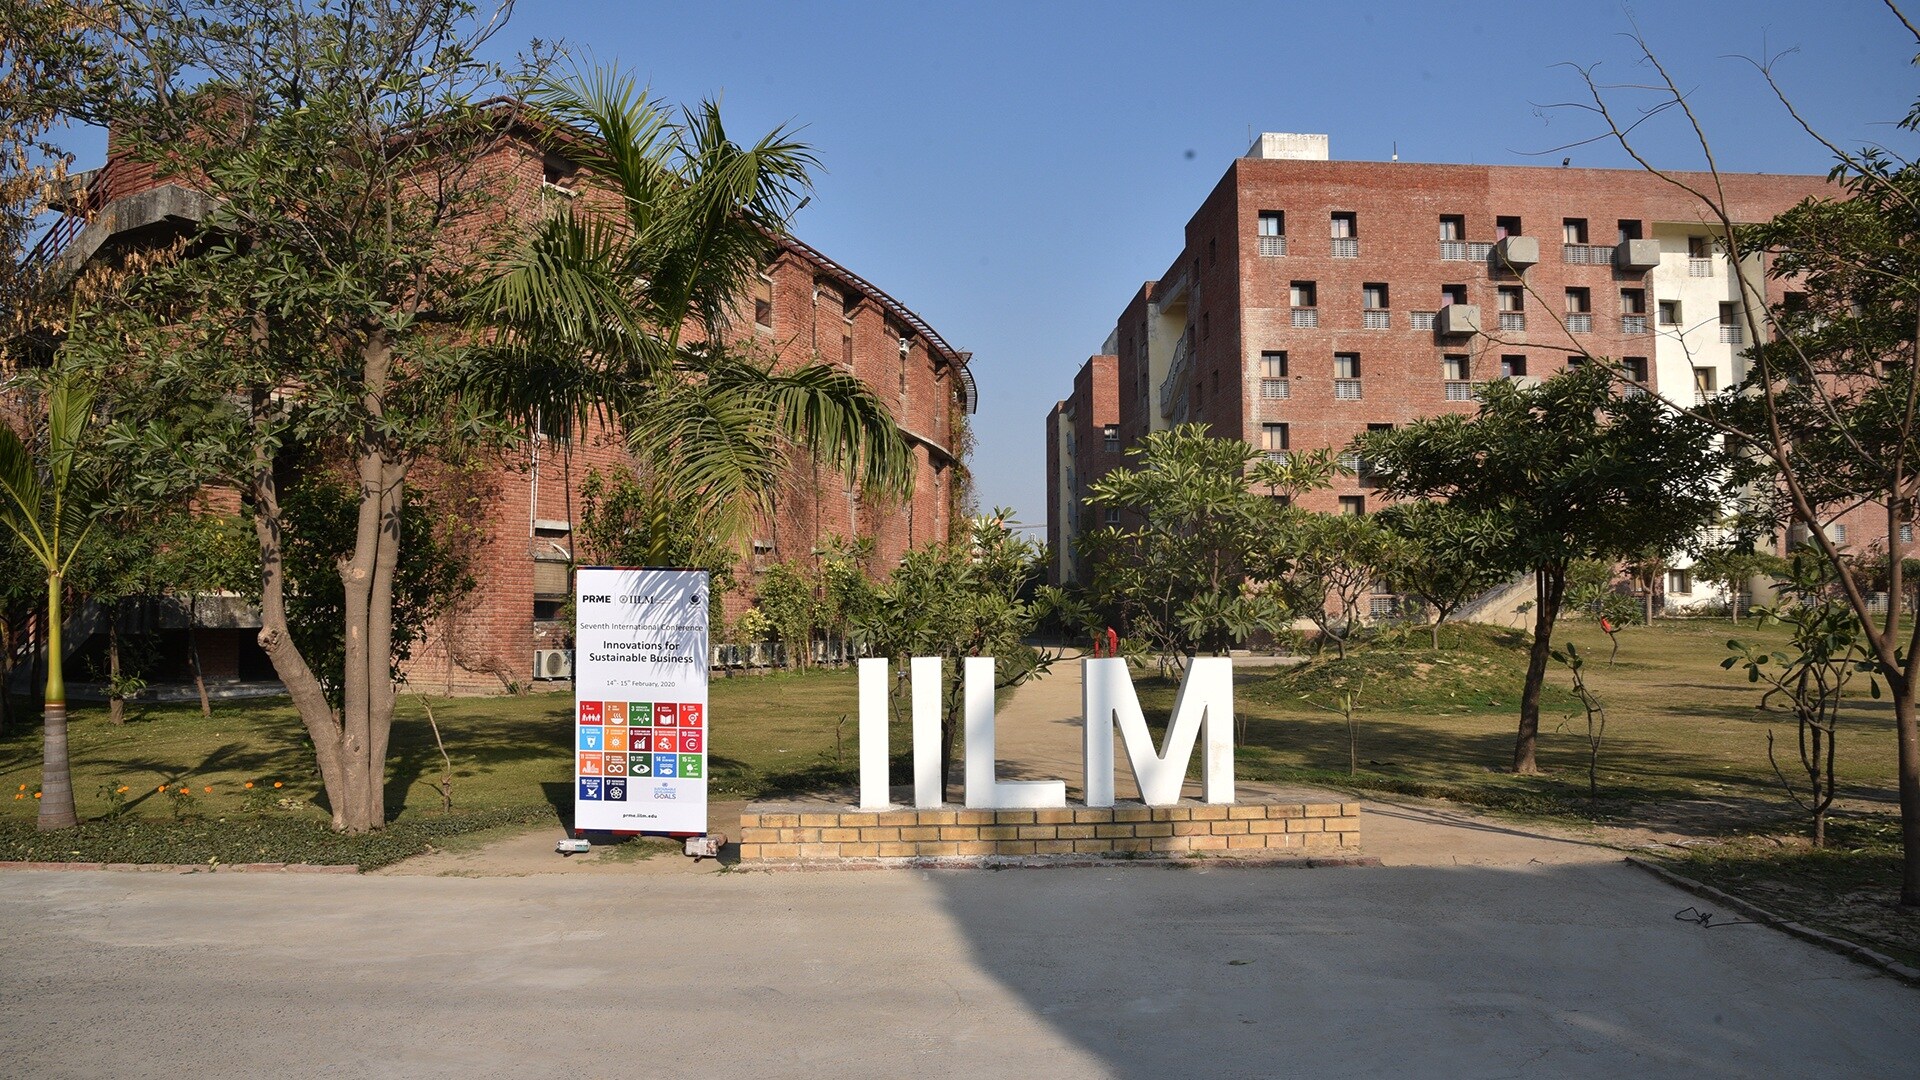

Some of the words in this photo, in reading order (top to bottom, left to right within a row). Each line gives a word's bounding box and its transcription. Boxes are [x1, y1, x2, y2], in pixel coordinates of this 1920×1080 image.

[582, 595, 611, 603] PRME
[612, 623, 658, 631] International
[603, 641, 662, 650] Innovations
[665, 641, 680, 651] for
[589, 653, 647, 662] Sustainable
[650, 654, 694, 664] Business
[858, 657, 1235, 809] IILM
